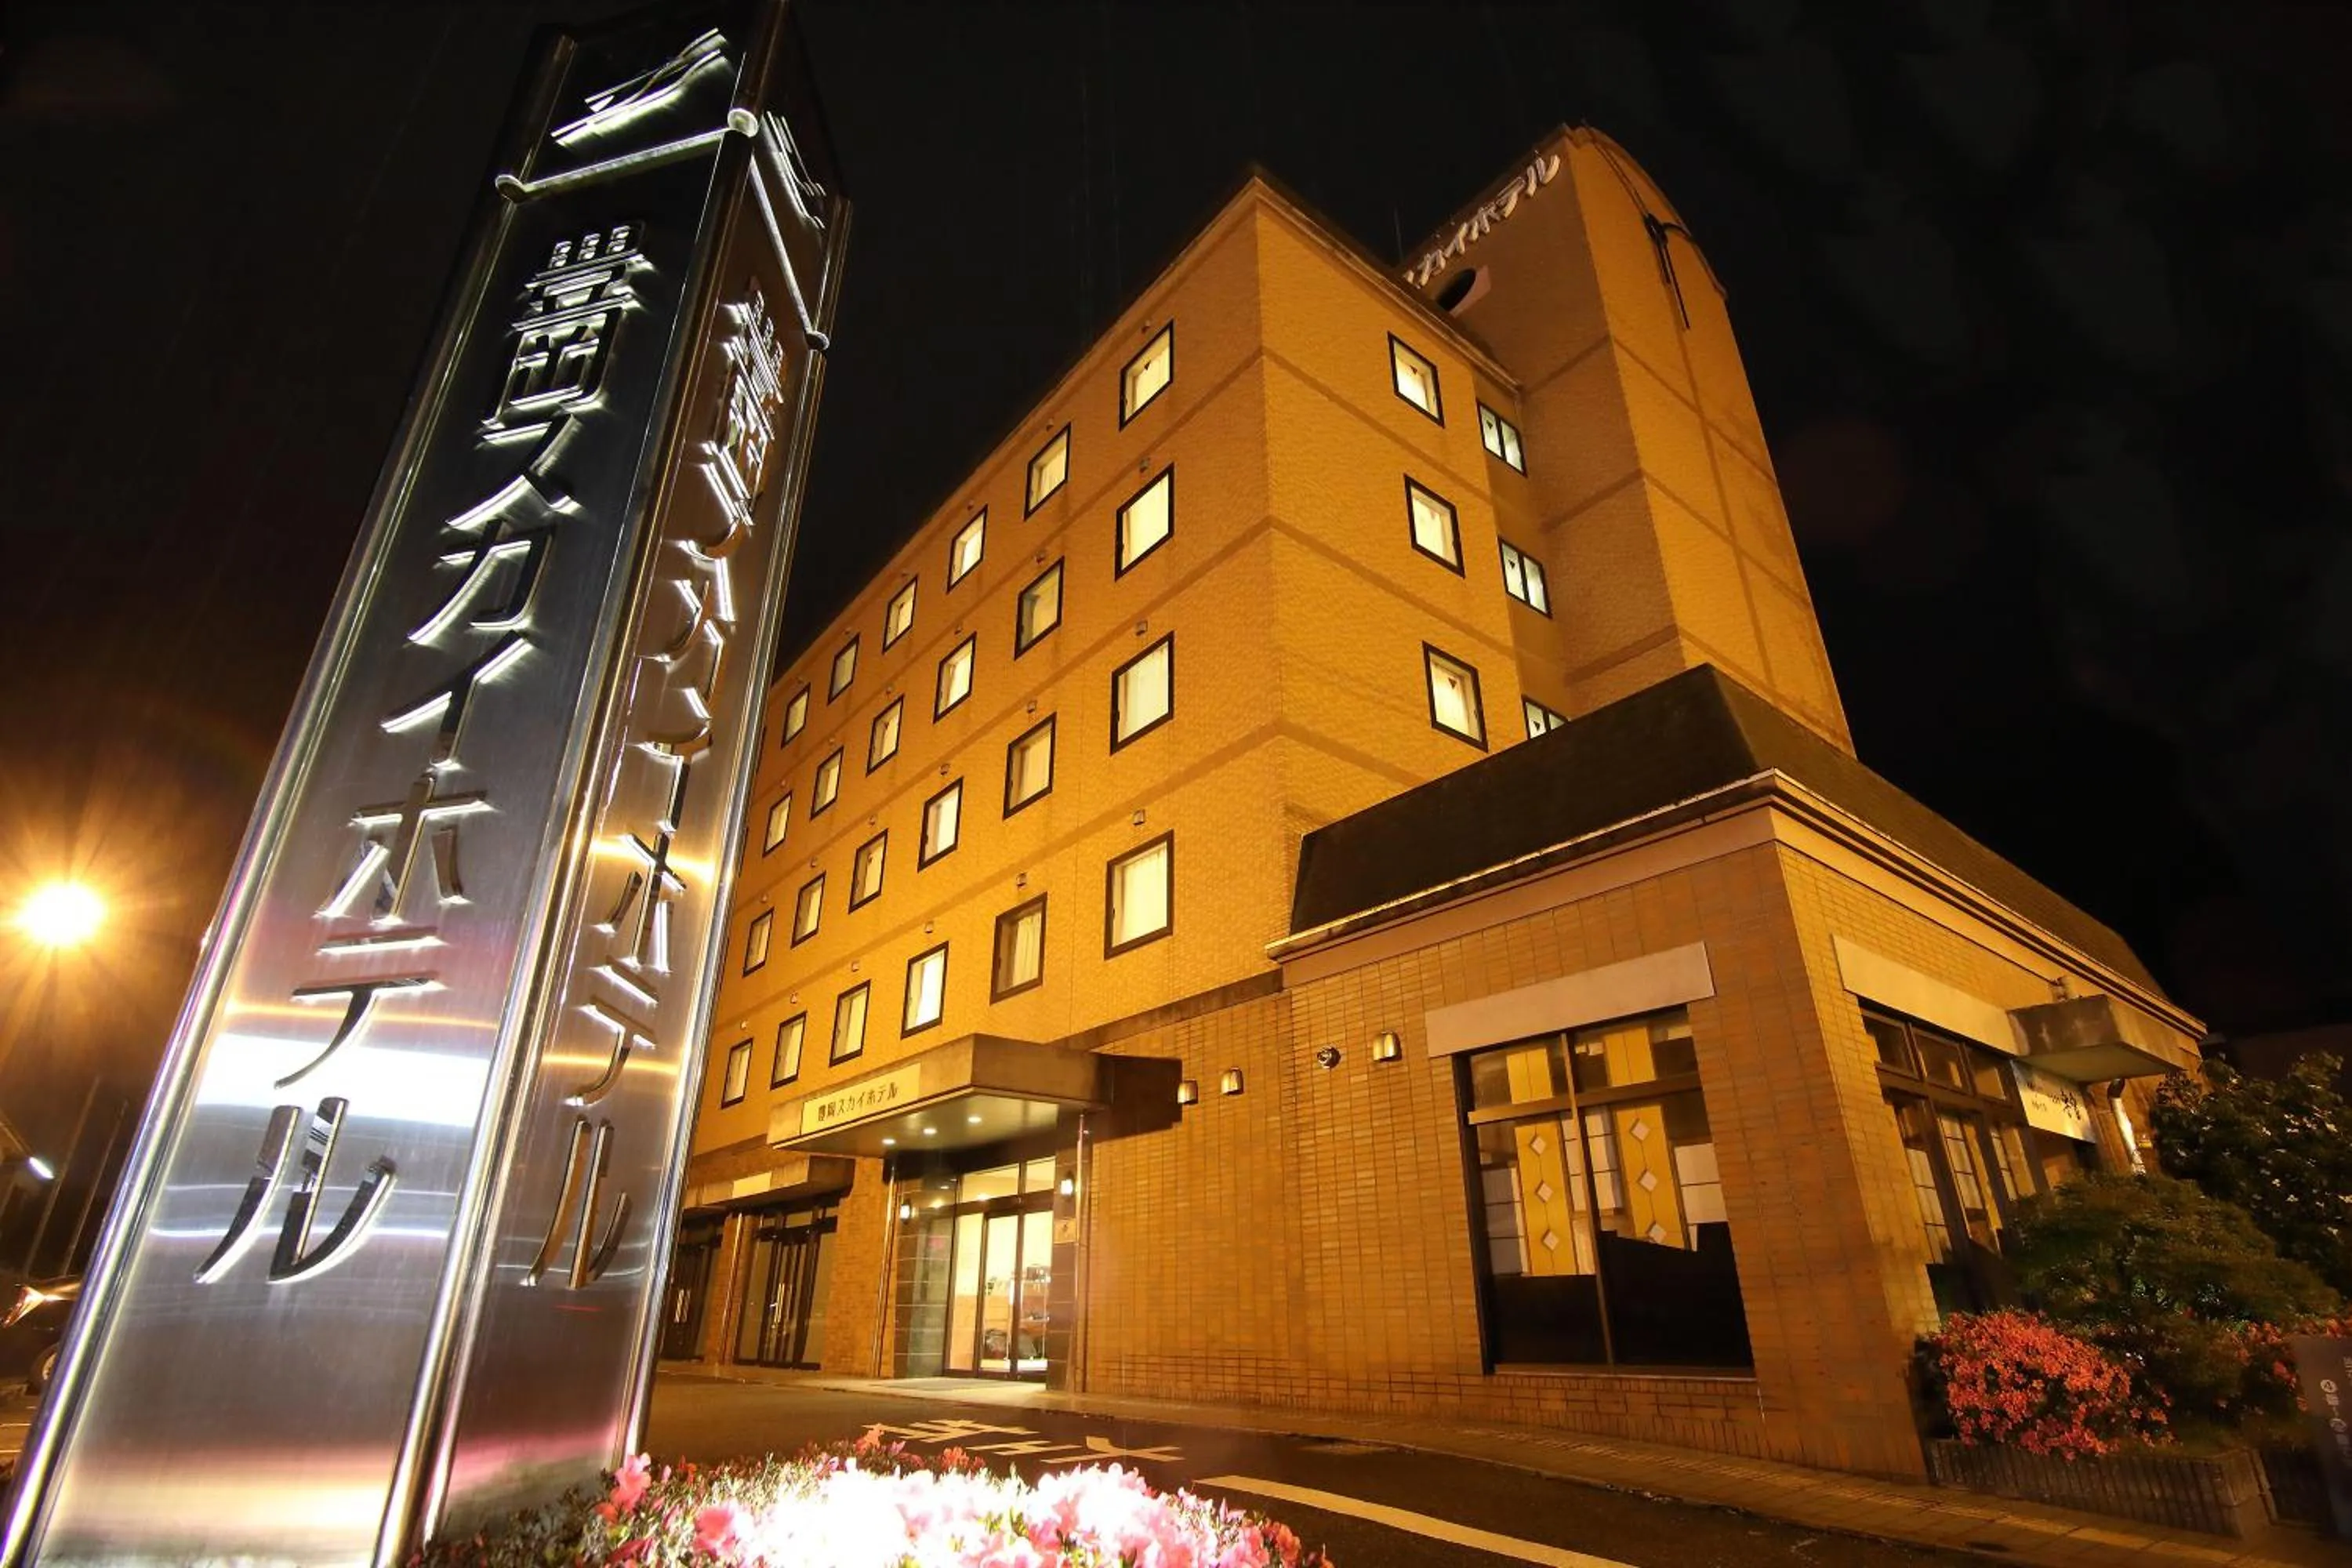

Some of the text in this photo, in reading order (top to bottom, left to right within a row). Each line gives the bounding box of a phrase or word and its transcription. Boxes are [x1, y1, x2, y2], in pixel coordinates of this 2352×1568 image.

[193, 222, 652, 1284] 豊岡スカイホテル
[818, 1081, 898, 1122] 豊岡スカイホテル
